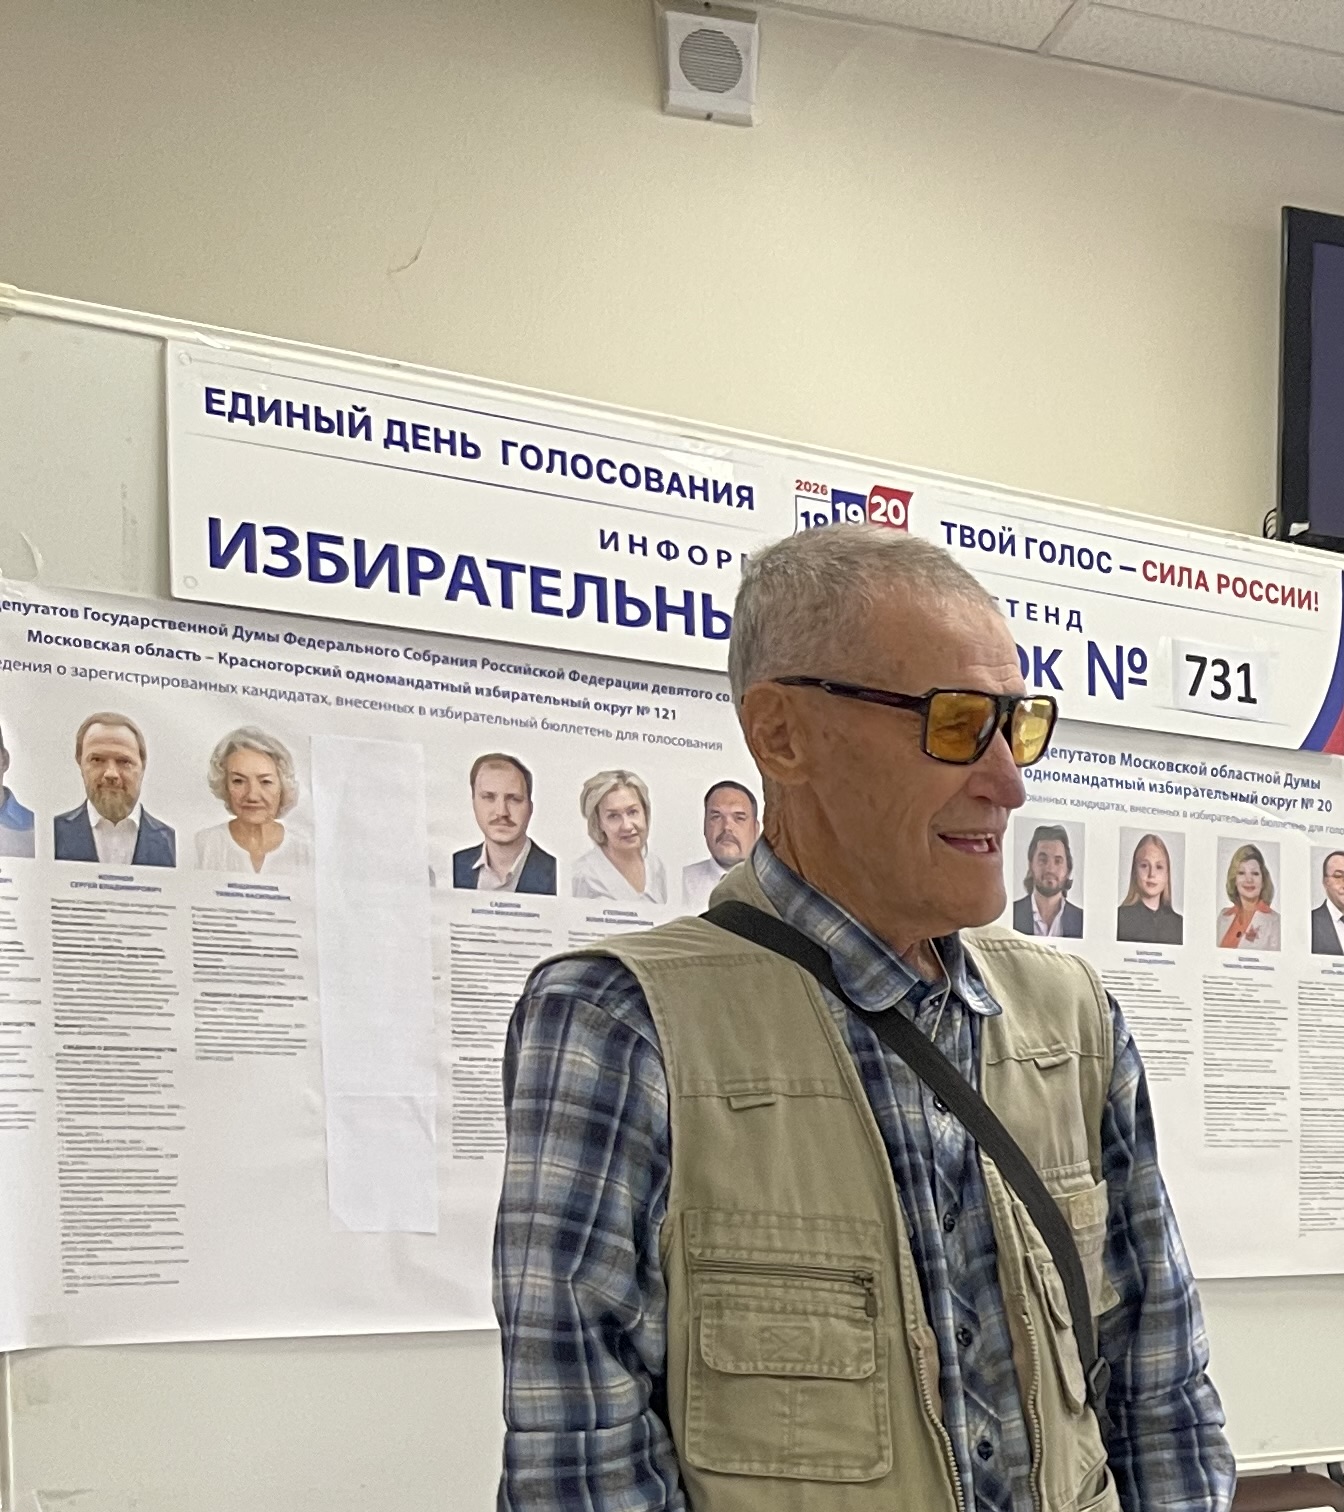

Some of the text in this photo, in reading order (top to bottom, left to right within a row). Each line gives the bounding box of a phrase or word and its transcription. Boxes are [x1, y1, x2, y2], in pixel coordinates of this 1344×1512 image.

[205, 386, 755, 510] ЕДИНЫЙ ДЕНЬ ГОЛОСОВАНИЯ
[795, 479, 828, 495] 2026
[835, 501, 865, 525] 19
[870, 494, 906, 526] 20
[940, 521, 1016, 557] ТВОЙ
[1025, 537, 1112, 573] ГОЛОС
[1142, 560, 1210, 592] СИЛА
[1217, 573, 1319, 612] РОССИИ!
[994, 597, 1083, 633] ТЕНД
[0, 600, 79, 619] епутатов
[83, 607, 228, 637] Государственной
[232, 625, 279, 643] Думы
[284, 632, 400, 659] Федерального
[403, 647, 477, 668] Собрания
[481, 657, 565, 680] Российской
[568, 670, 648, 693] Федерации
[651, 684, 712, 700] девятого
[27, 629, 130, 653] Московская
[134, 643, 201, 662] область
[218, 651, 341, 678] Красногорский
[346, 669, 471, 694] одномандатный
[475, 685, 590, 710] избирательный
[593, 701, 633, 717] округ
[654, 707, 676, 720] 121
[1087, 640, 1148, 701] №
[1185, 654, 1258, 704] 731
[56, 665, 67, 676] о
[70, 666, 238, 695] зарегистрированных
[242, 685, 331, 706] кандидатах,
[335, 696, 414, 714] внесенных
[418, 705, 426, 716] в
[430, 706, 537, 730] избирательный
[541, 718, 613, 738] бюллетень
[615, 729, 639, 742] для
[642, 732, 723, 751] голосования
[1024, 768, 1145, 792] одномандатный
[1149, 781, 1258, 805] избирательный
[1261, 794, 1298, 811] округ
[1317, 799, 1332, 812] 20
[1120, 752, 1207, 777] Московской
[1210, 764, 1281, 785] областной
[1284, 772, 1320, 790] Думы
